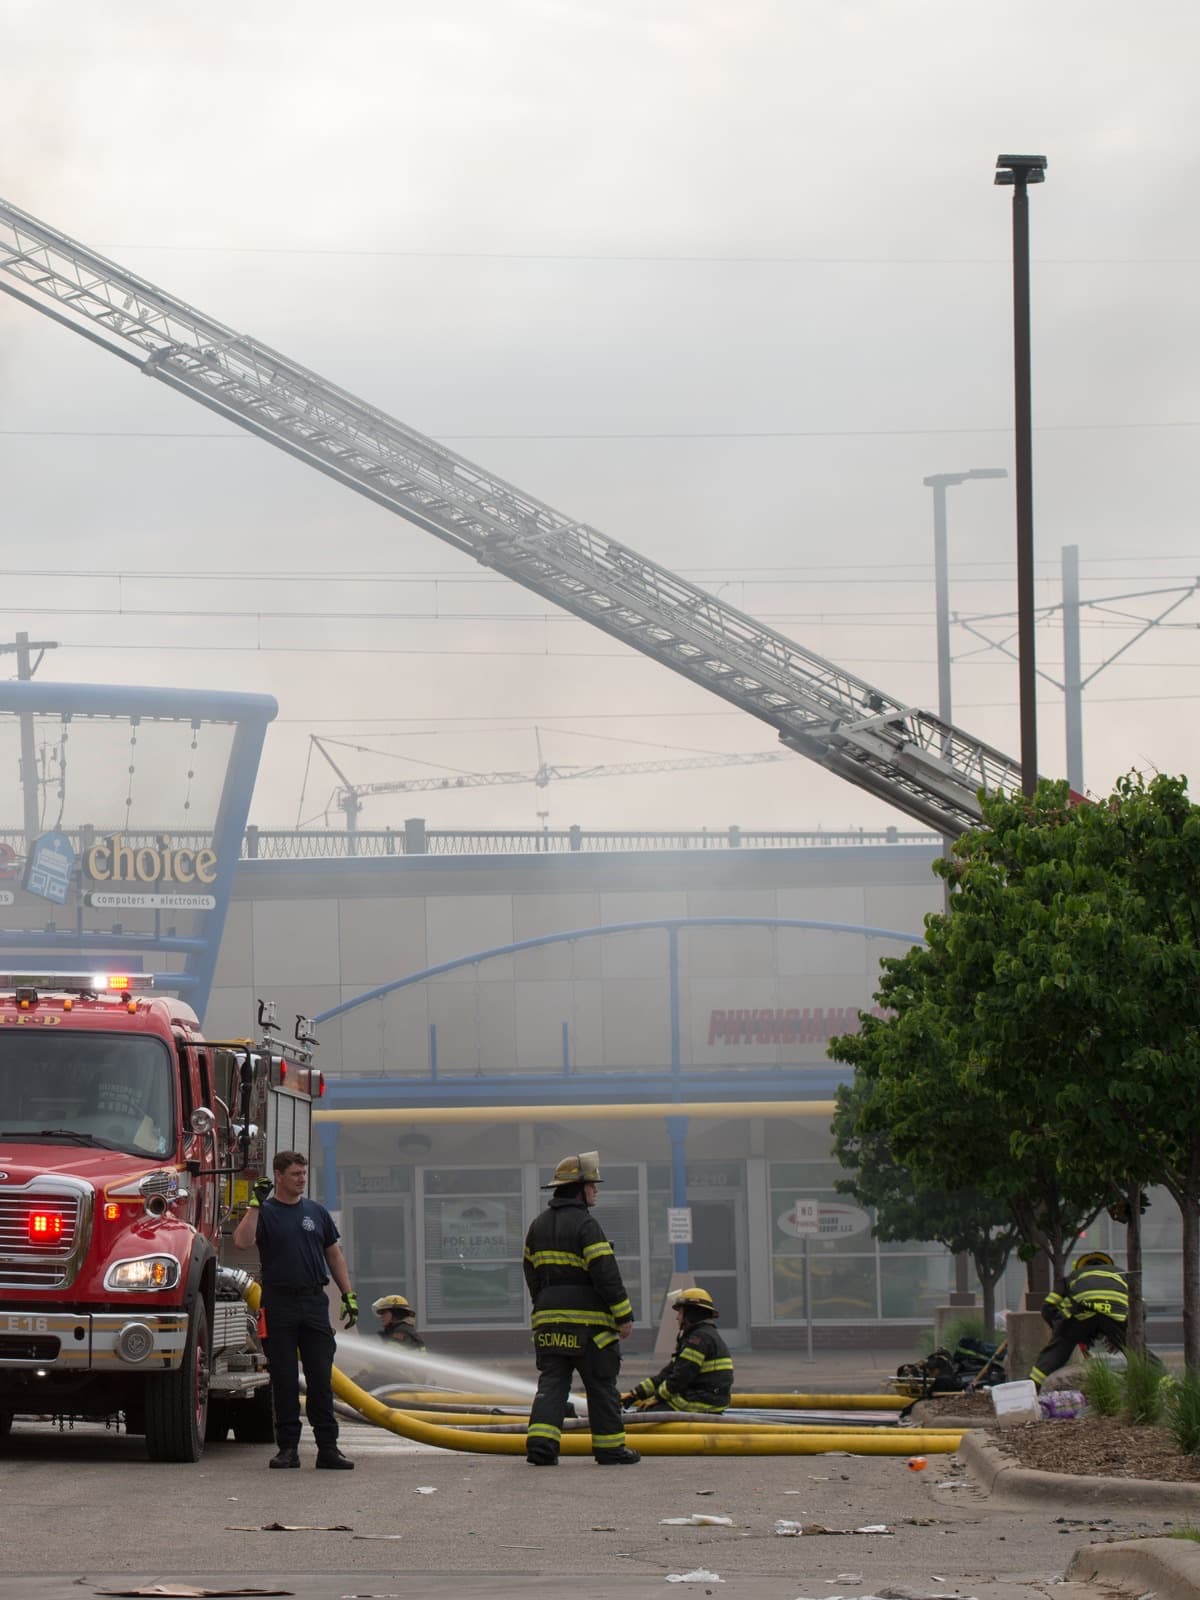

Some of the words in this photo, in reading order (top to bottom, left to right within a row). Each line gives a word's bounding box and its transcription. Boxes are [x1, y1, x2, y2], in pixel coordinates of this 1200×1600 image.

[86, 832, 218, 884] choice
[96, 894, 146, 906] computers
[160, 894, 211, 907] electronics
[800, 1206, 814, 1217] NO
[442, 1236, 465, 1246] FOR
[470, 1235, 506, 1246] LEASE
